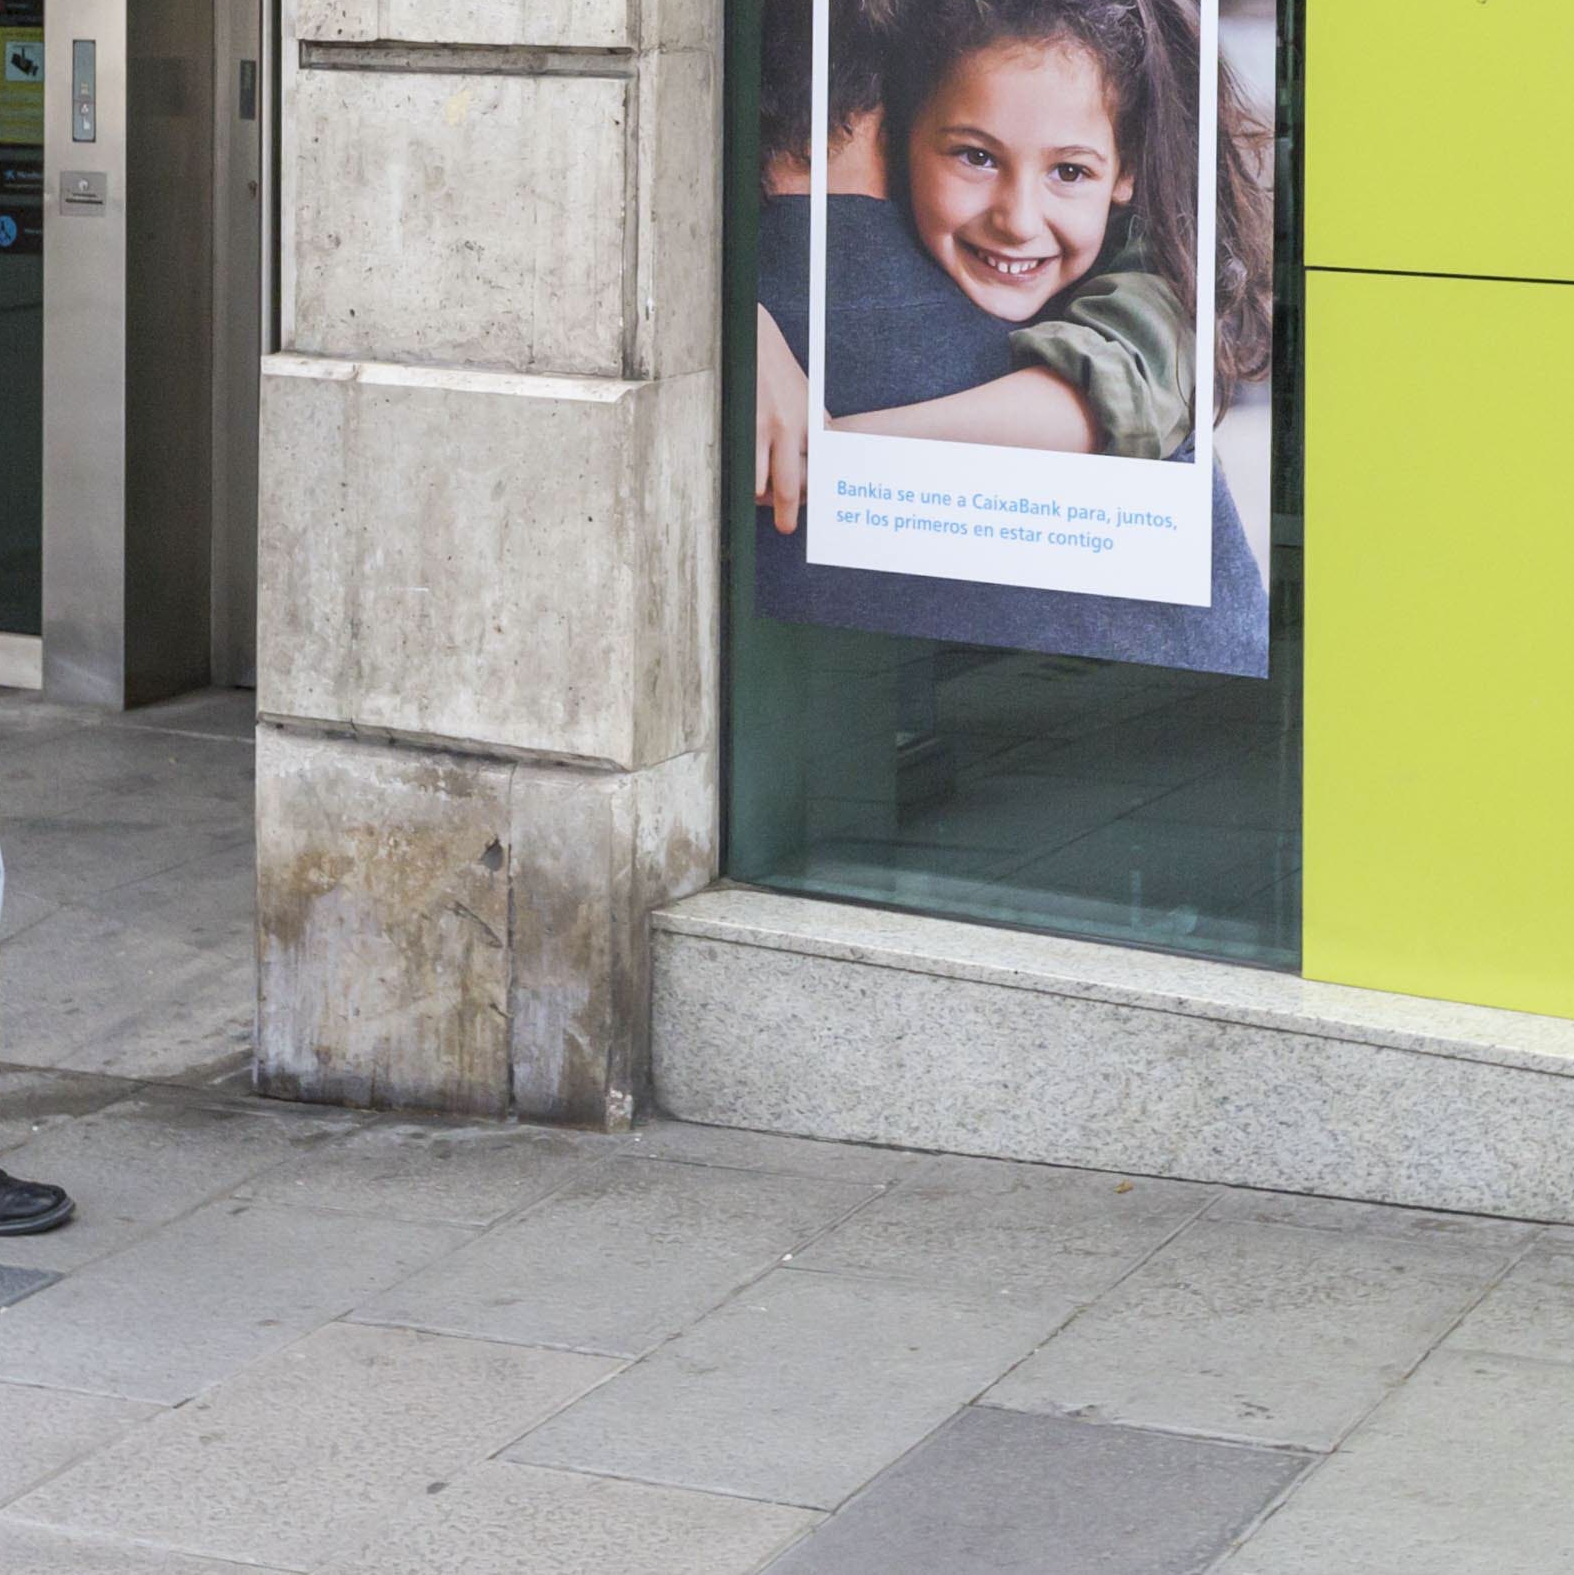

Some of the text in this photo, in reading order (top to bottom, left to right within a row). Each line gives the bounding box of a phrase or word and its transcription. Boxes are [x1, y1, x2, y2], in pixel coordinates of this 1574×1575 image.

[837, 480, 1178, 531] Bankia se une a CaixaBank para, juntos,
[836, 509, 1115, 554] ser los primeros en estar contigo
